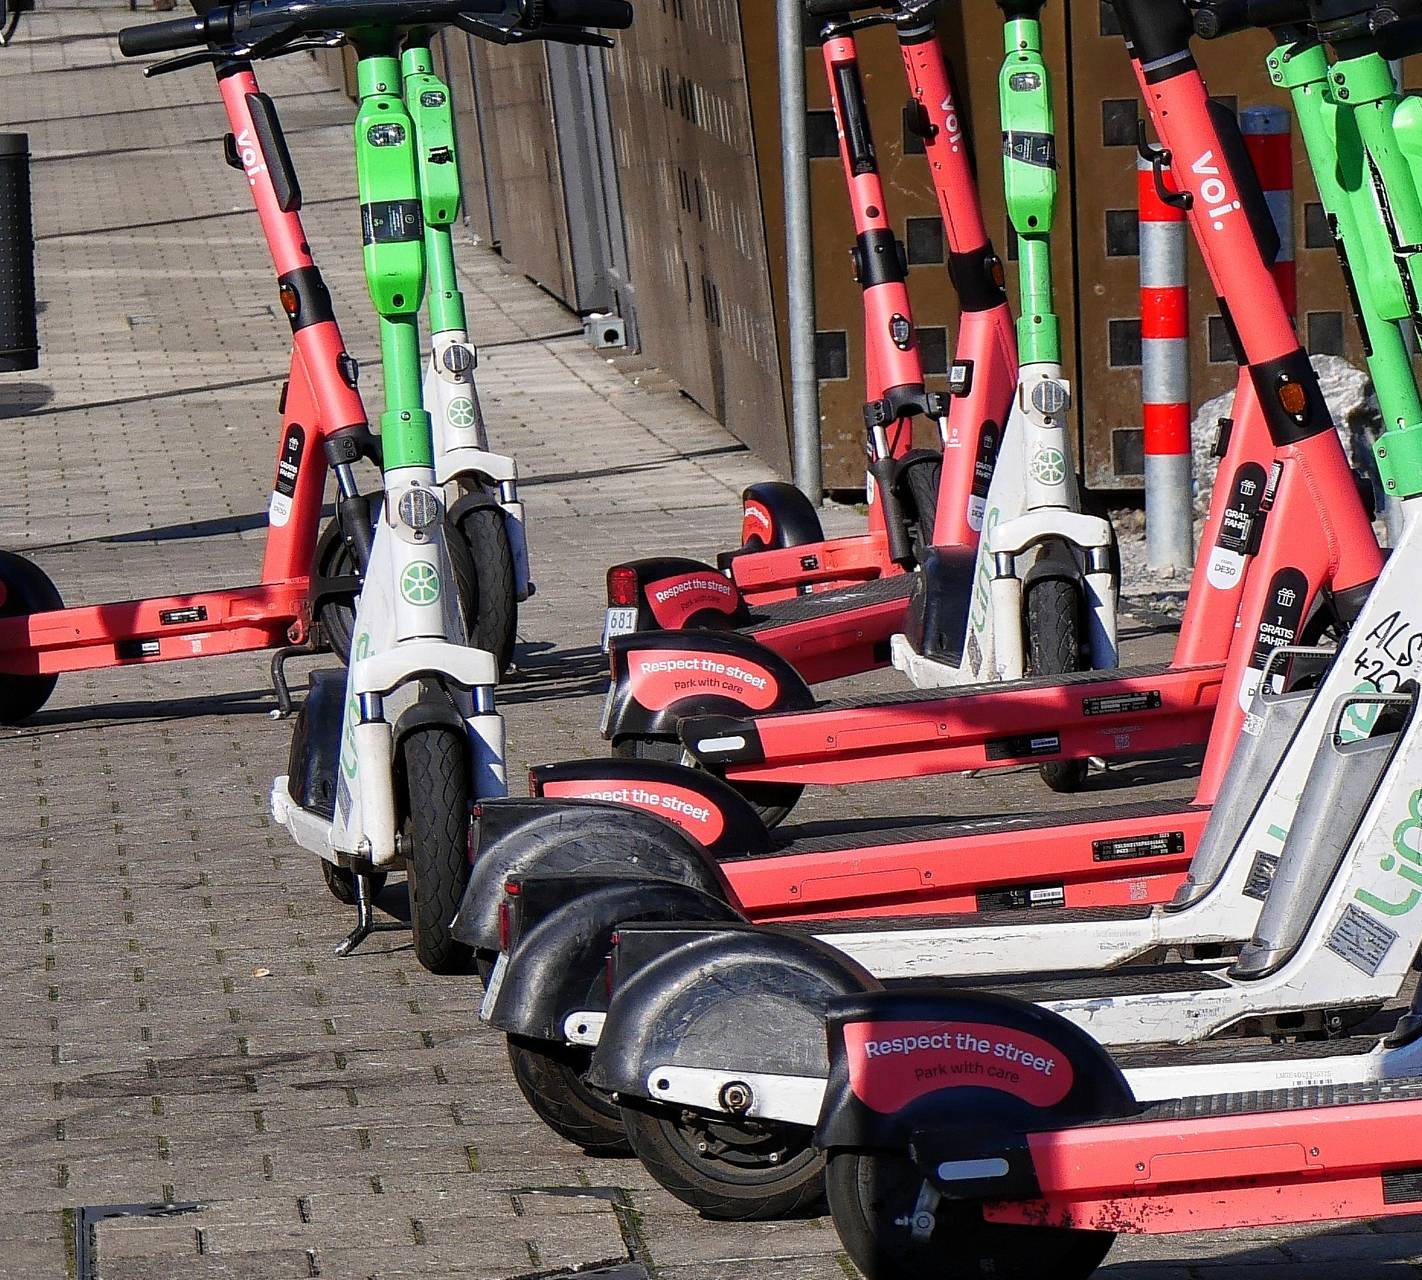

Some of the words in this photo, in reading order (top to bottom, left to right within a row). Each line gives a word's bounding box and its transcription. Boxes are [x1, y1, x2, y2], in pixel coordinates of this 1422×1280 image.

[237, 128, 266, 186] voi.
[1191, 149, 1242, 231] voi.
[1225, 508, 1249, 521] GRAT
[1239, 503, 1246, 512] 1
[1214, 563, 1236, 576] DE30
[655, 580, 693, 604] Respect
[693, 579, 707, 590] the
[707, 580, 731, 596] street
[610, 612, 633, 629] 681
[1277, 616, 1283, 625] 1
[1258, 633, 1291, 647] FAHRT
[1259, 622, 1294, 640] GRATIS
[640, 658, 700, 675] Respect
[702, 659, 725, 674] the
[726, 665, 767, 690] street
[674, 680, 697, 691] Park
[698, 678, 720, 688] with
[722, 681, 743, 694] care
[631, 789, 660, 806] the
[661, 796, 711, 823] street
[864, 1032, 952, 1060] Respect
[955, 1033, 990, 1054] the
[993, 1041, 1056, 1076] street
[914, 1062, 948, 1082] Park
[949, 1061, 984, 1074] with
[987, 1066, 1020, 1083] care
